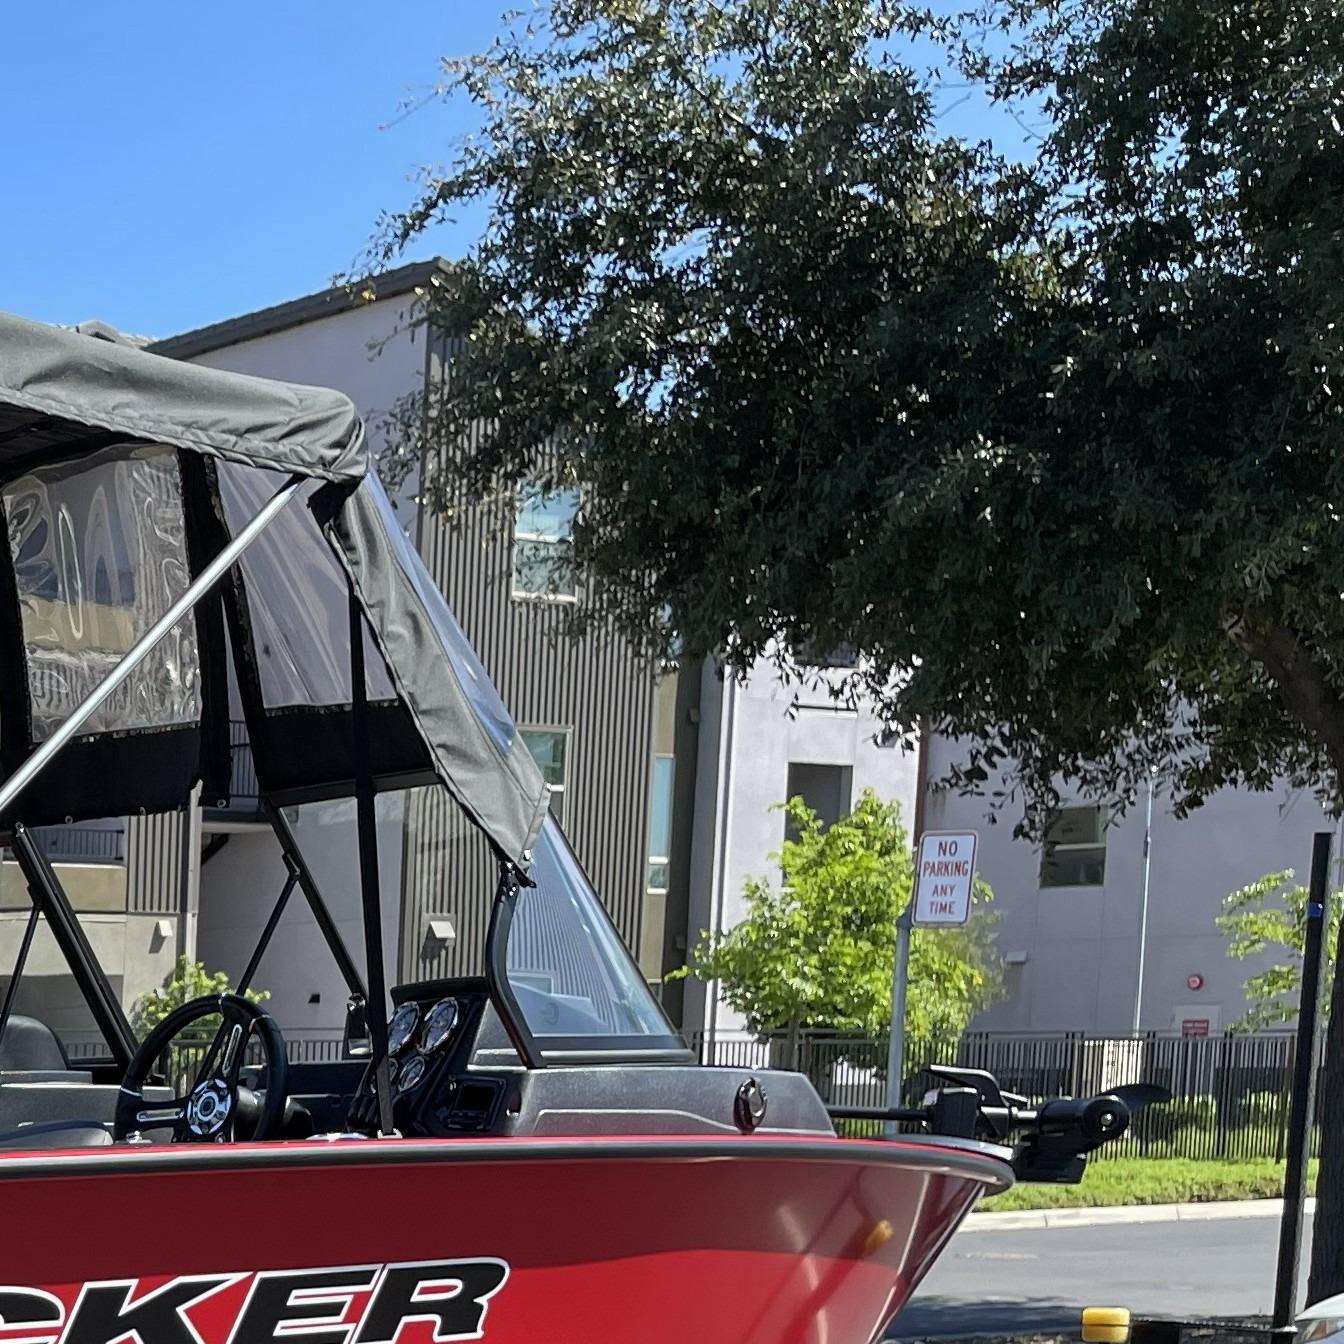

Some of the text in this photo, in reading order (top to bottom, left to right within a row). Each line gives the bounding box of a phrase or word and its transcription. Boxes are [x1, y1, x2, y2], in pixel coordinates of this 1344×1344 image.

[937, 840, 958, 857] NO
[922, 860, 969, 878] PARKING
[932, 884, 956, 897] ANY
[929, 900, 956, 915] TIME
